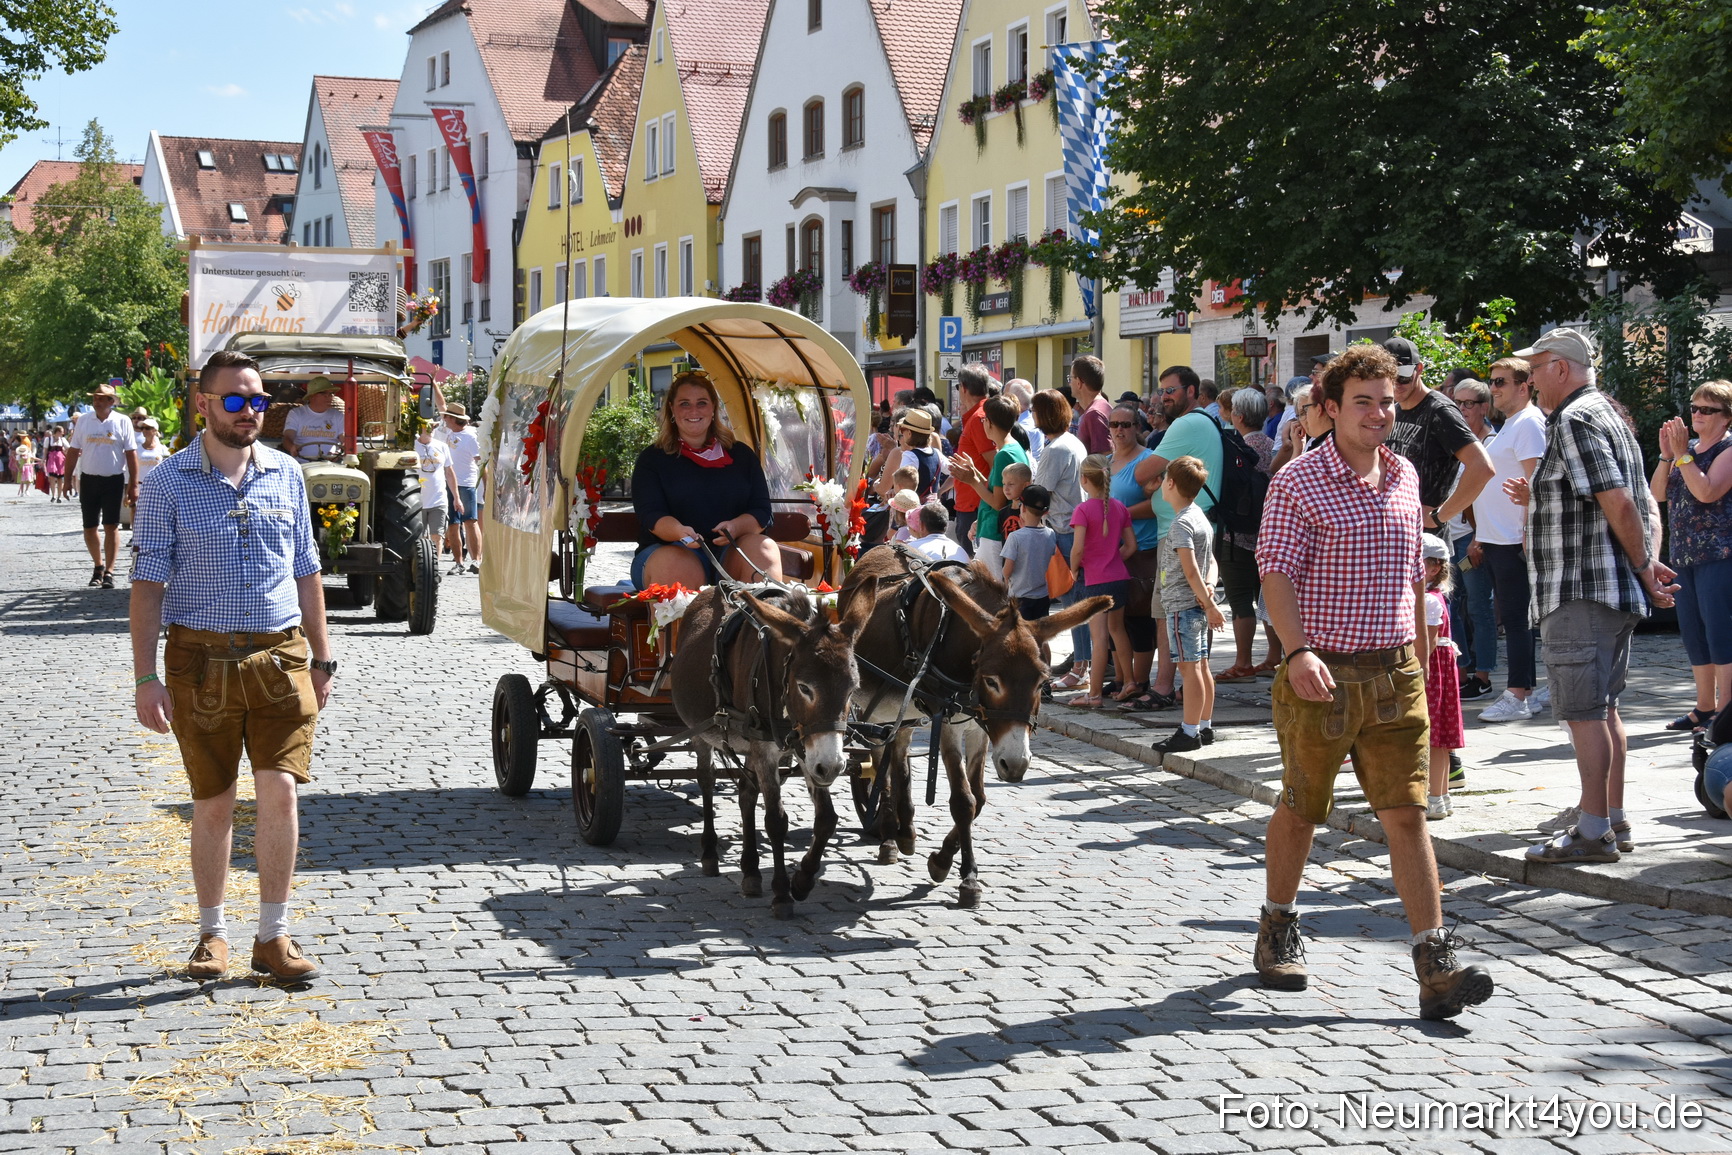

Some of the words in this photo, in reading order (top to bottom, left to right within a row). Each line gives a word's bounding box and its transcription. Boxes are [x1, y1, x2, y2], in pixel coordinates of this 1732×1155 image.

[590, 228, 616, 247] Lehmeier
[202, 267, 253, 276] Unterstützer
[256, 269, 290, 277] gesucht
[291, 269, 306, 277] für:
[1128, 291, 1149, 307] RIALTO
[1150, 290, 1165, 304] KINO
